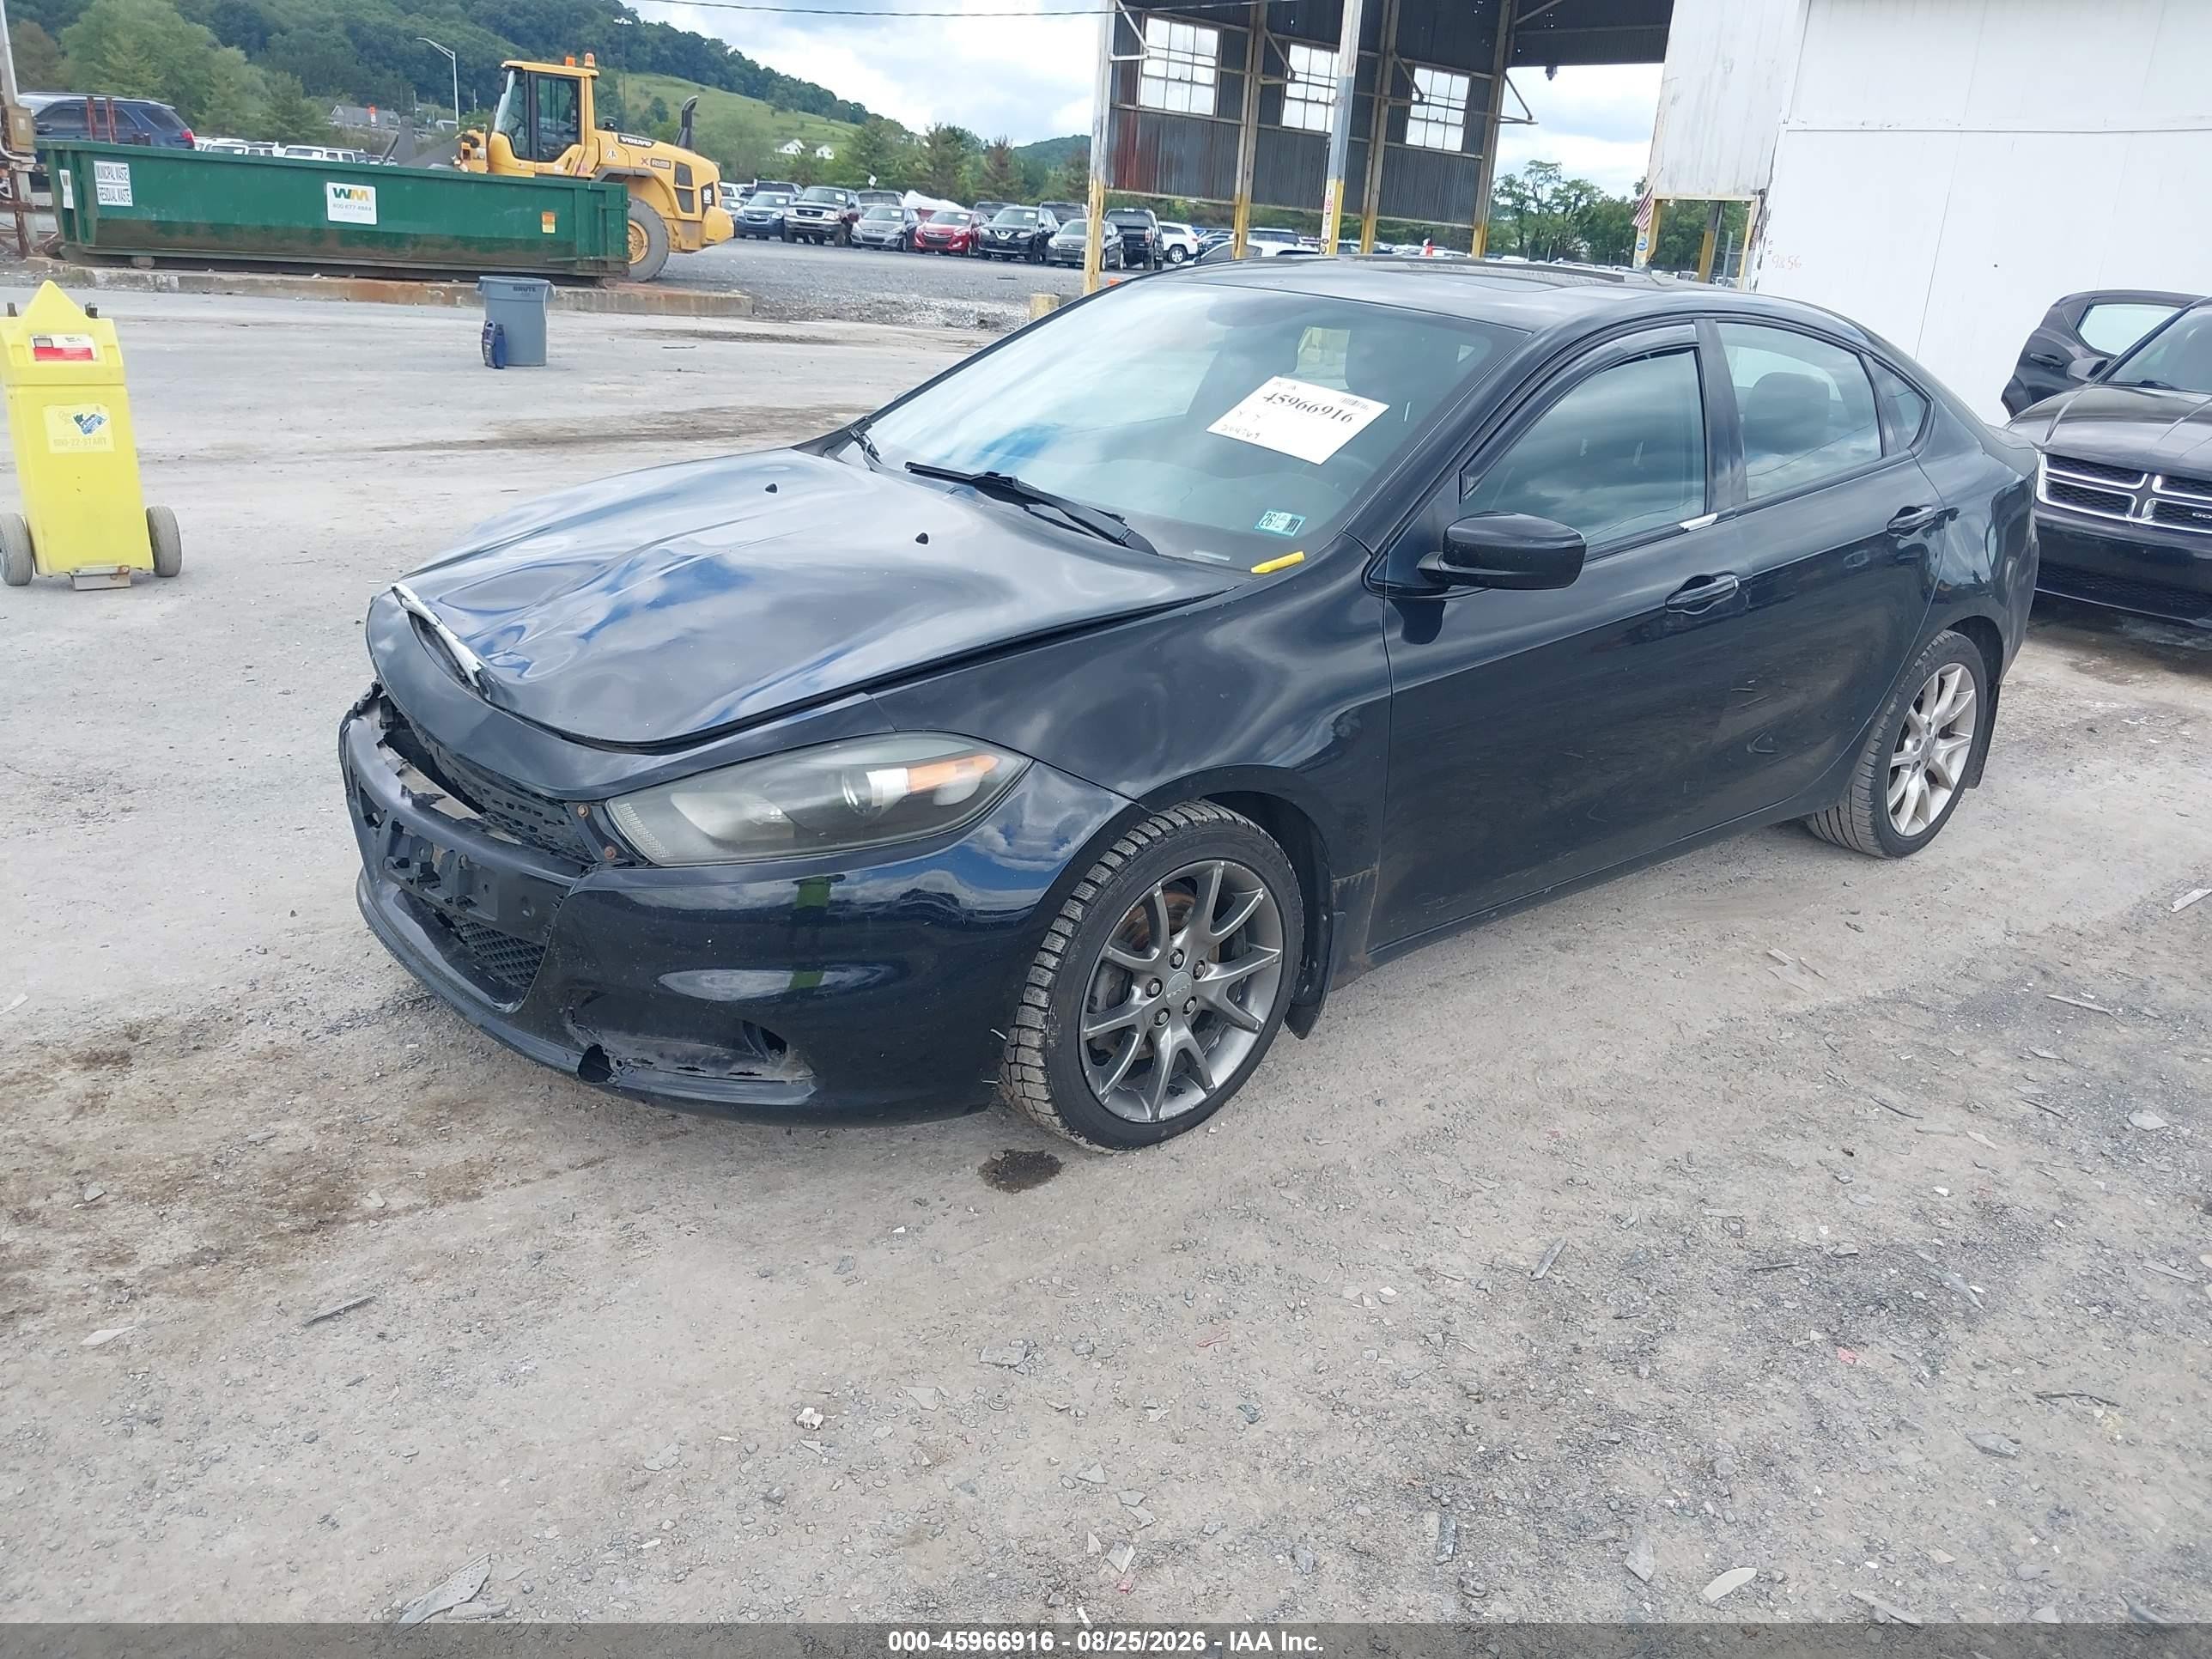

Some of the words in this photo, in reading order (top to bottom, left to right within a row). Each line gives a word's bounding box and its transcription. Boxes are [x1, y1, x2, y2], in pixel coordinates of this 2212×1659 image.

[620, 137, 653, 147] VOLVO
[332, 187, 368, 201] WM
[1262, 392, 1357, 423] 45966916
